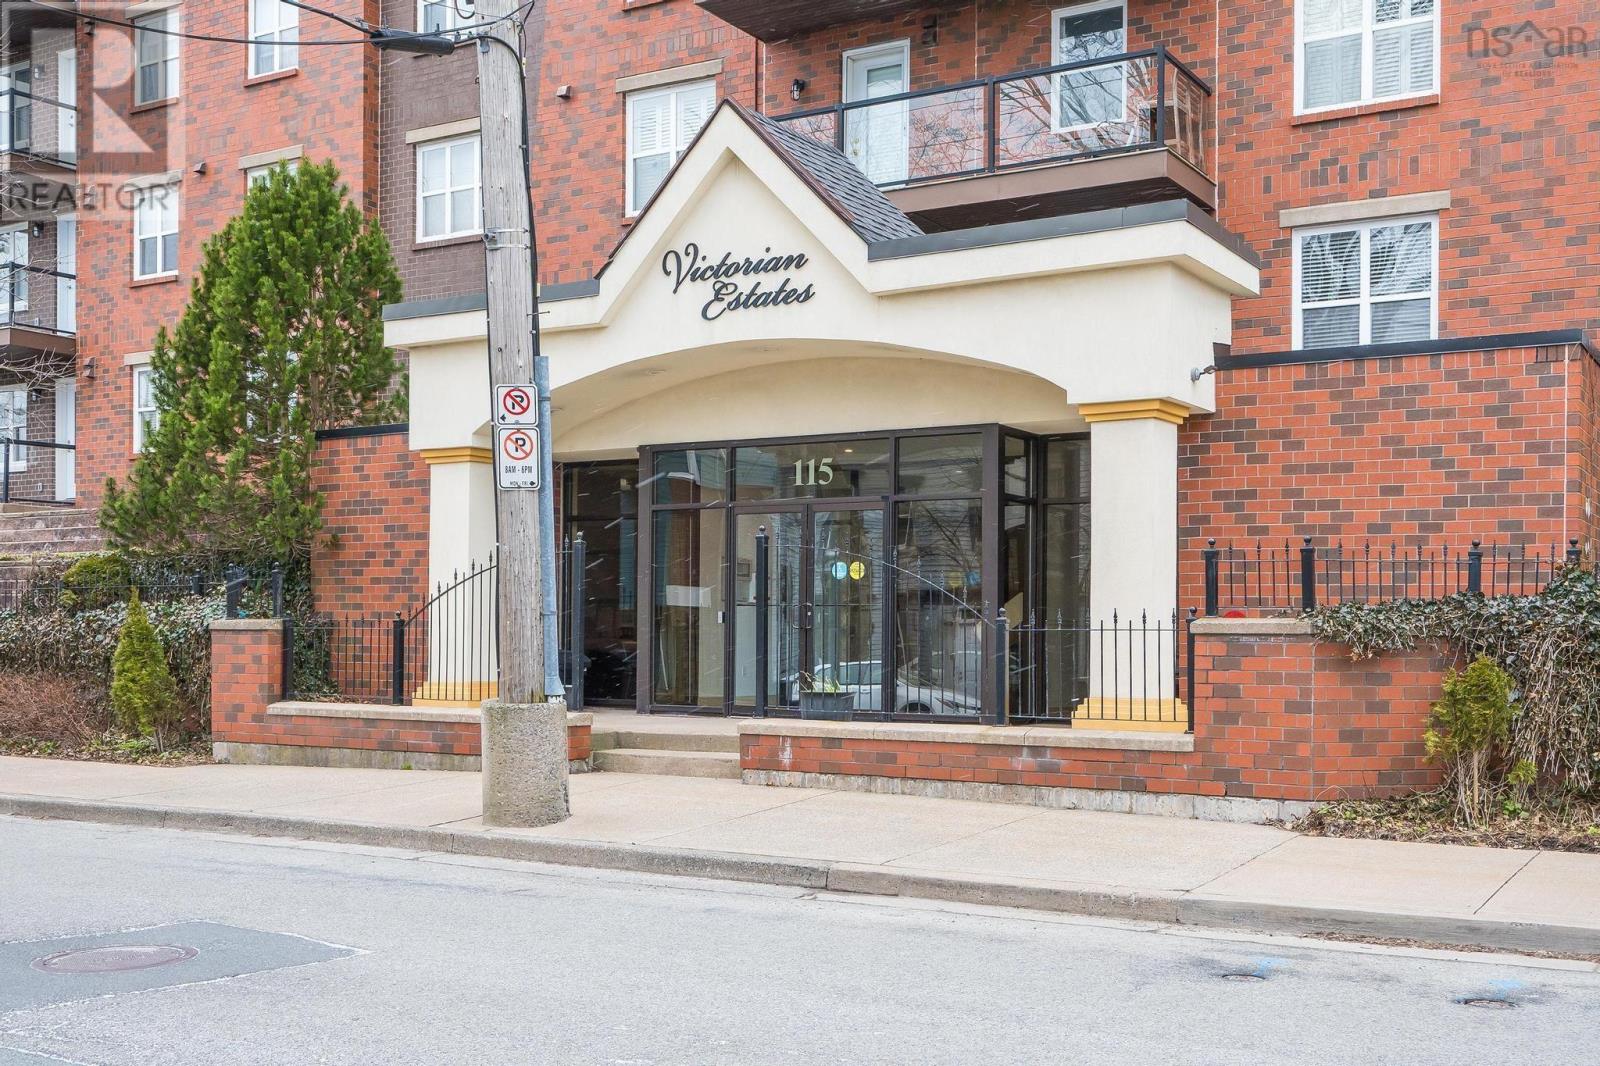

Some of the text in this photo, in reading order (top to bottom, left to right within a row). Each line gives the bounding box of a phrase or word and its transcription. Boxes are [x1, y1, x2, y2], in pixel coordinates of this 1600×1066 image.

[662, 242, 809, 294] Victorian
[701, 278, 816, 321] Estates
[504, 465, 517, 474] 8AM
[521, 465, 533, 474] 6PM
[793, 457, 834, 486] 115
